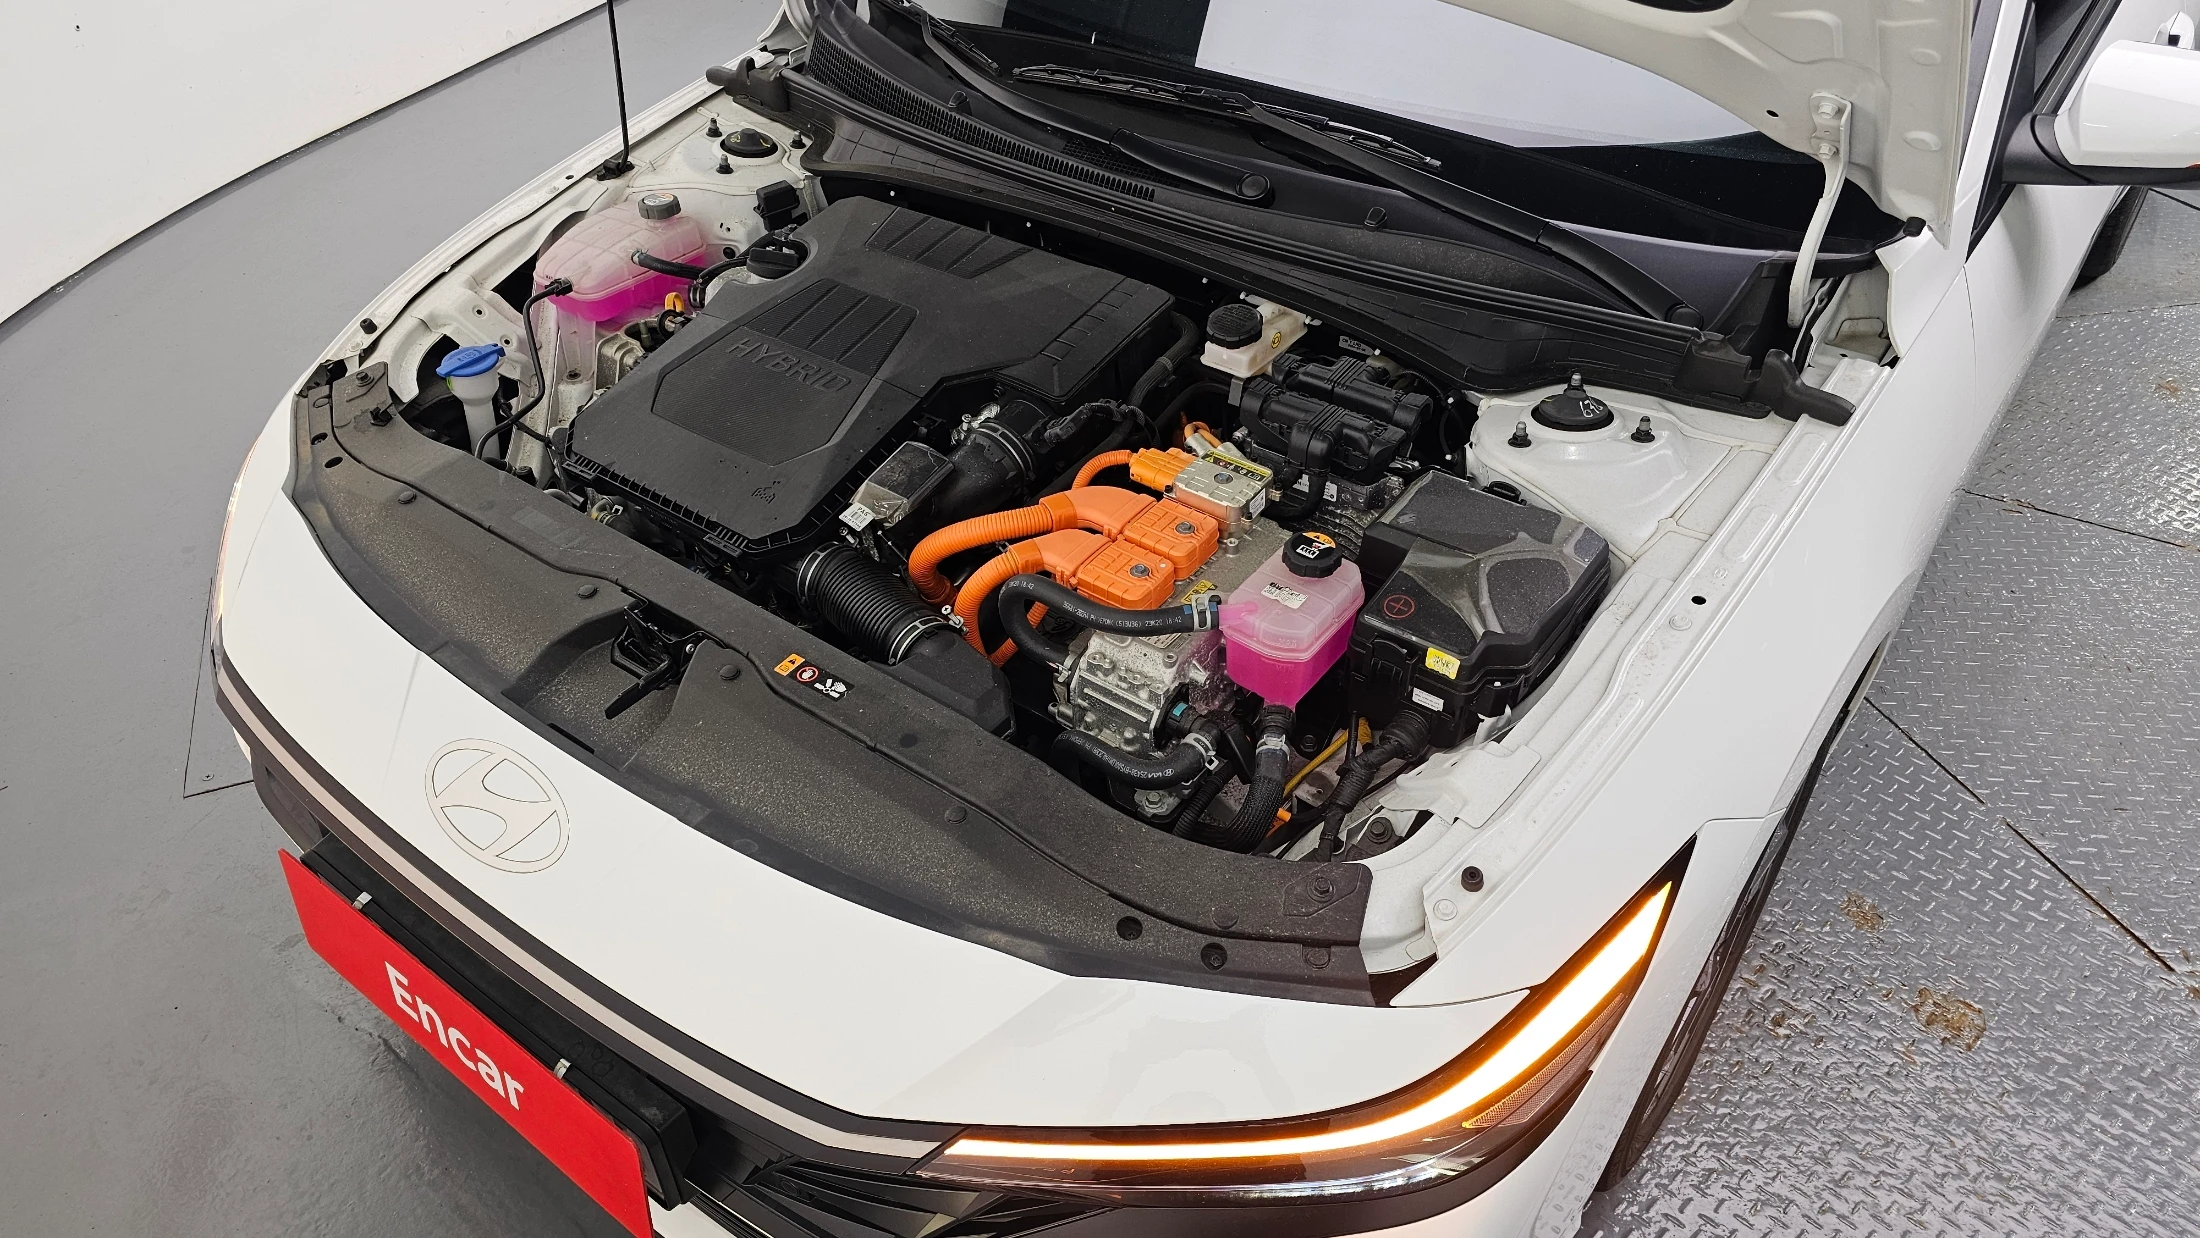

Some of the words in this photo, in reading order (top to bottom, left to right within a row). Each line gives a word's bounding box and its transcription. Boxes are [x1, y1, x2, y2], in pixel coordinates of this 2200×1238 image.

[726, 338, 852, 392] HYBRID
[1166, 615, 1182, 625] 18:42
[384, 961, 525, 1111] Encar
